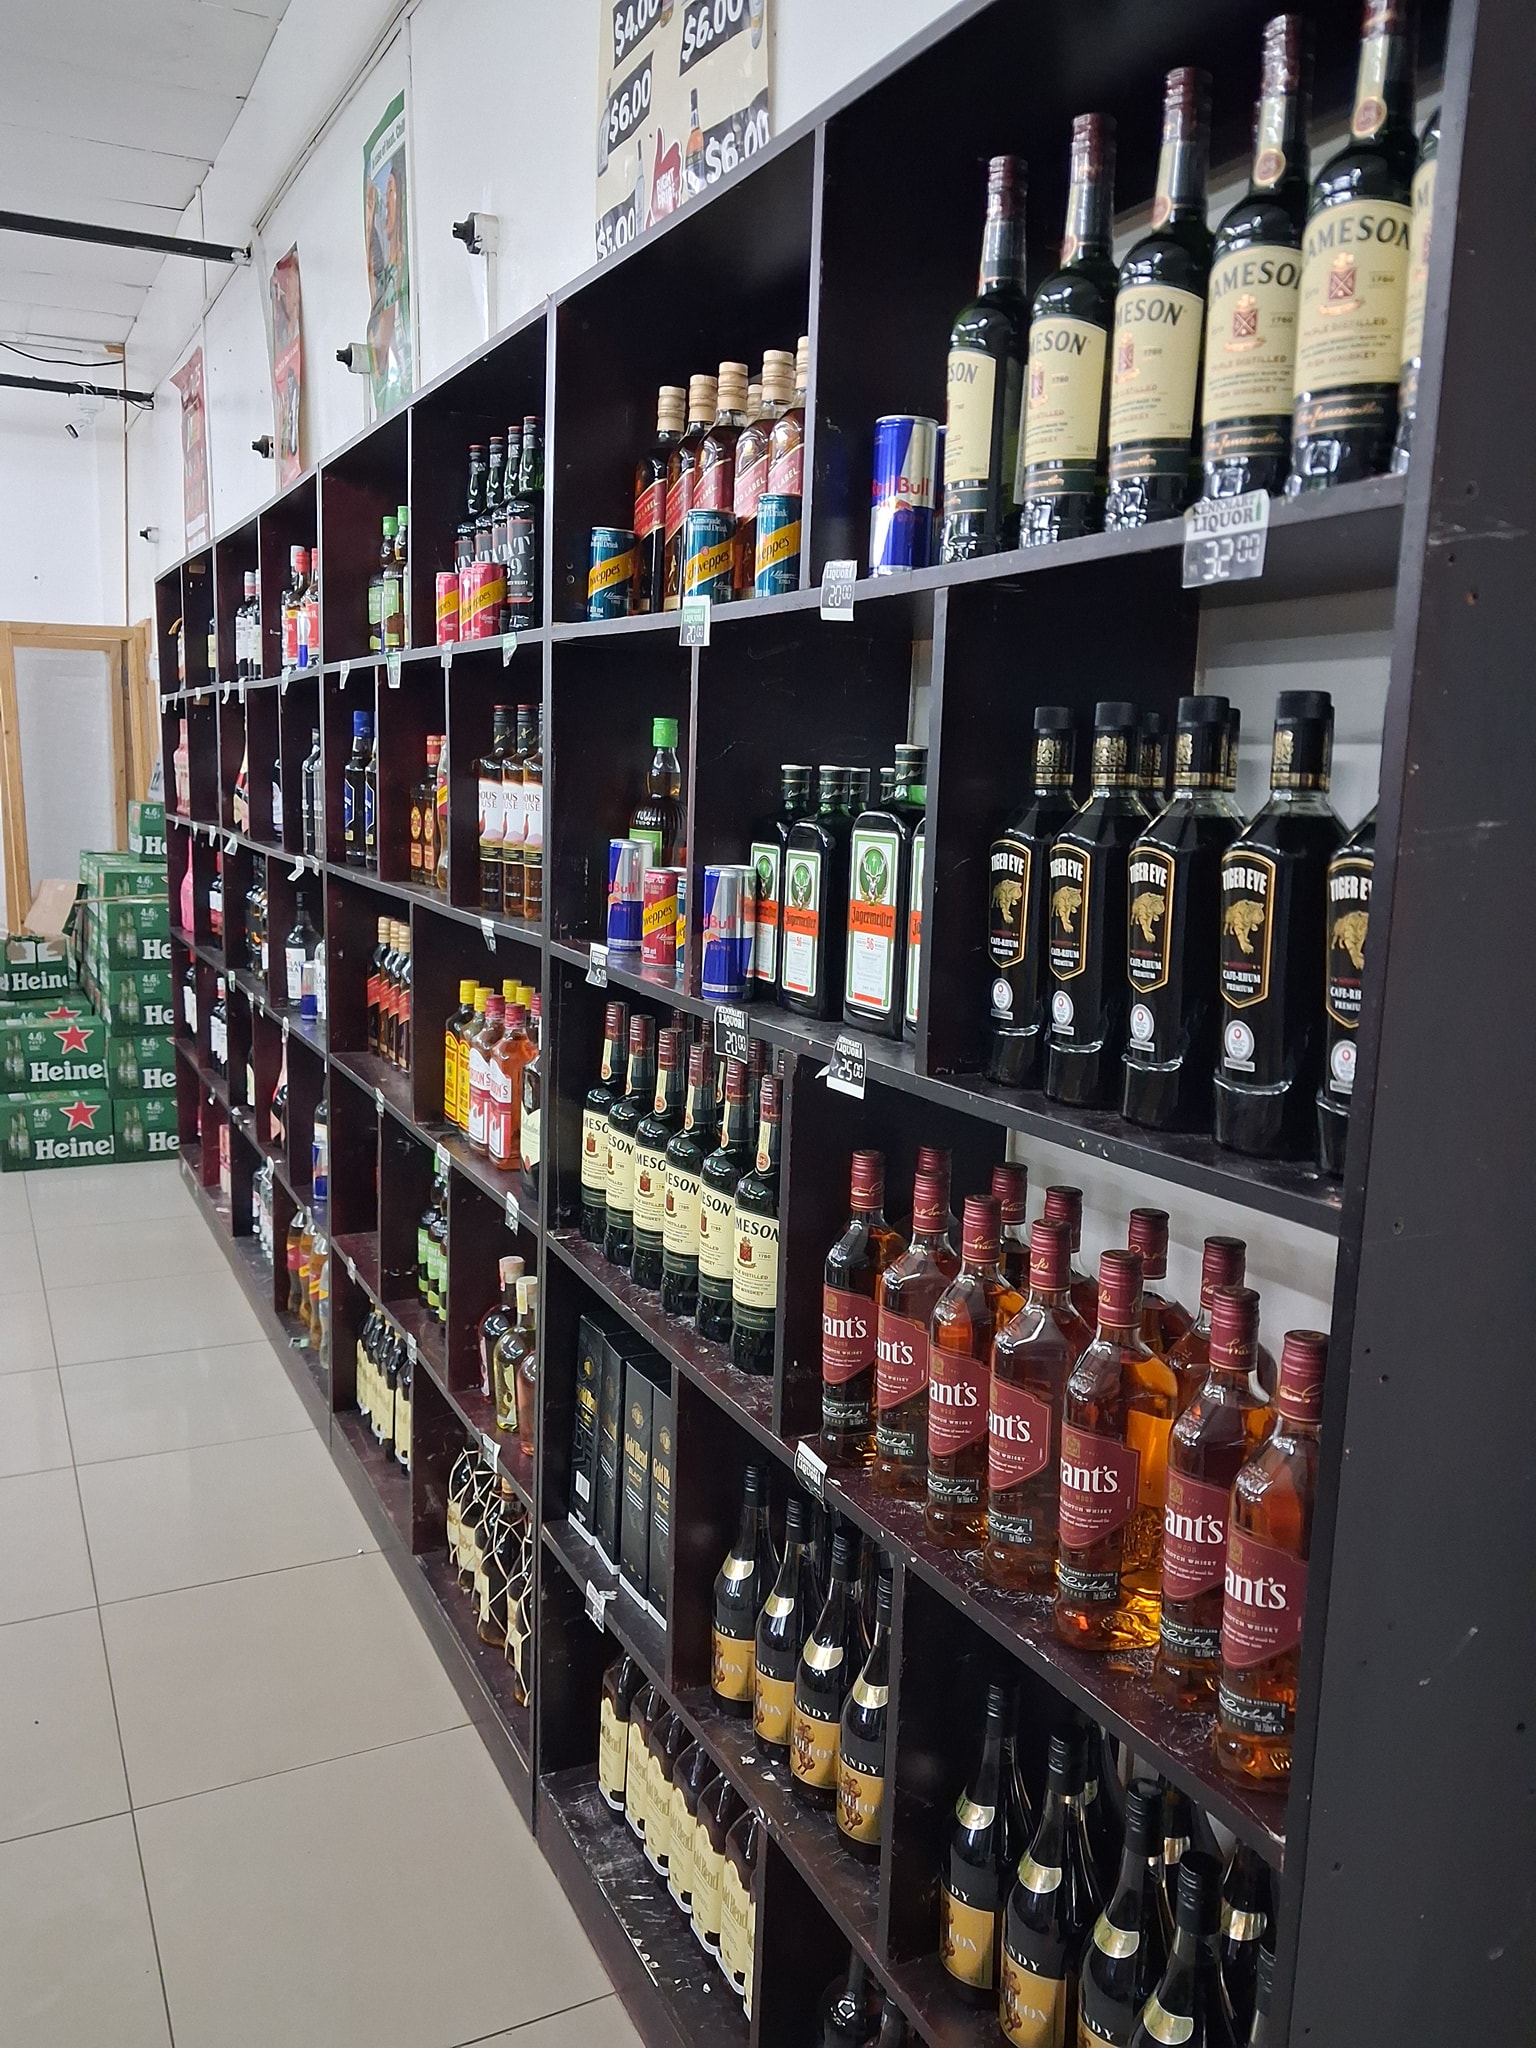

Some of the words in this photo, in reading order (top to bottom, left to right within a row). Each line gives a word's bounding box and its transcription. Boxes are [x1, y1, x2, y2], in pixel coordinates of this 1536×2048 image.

[610, 69, 651, 143] $6.00
[706, 109, 768, 183] $6.00
[897, 475, 929, 497] Bull
[1193, 507, 1254, 533] LIQUOR
[1202, 538, 1235, 580] 32
[1237, 533, 1261, 563] 00
[828, 585, 841, 607] 20
[991, 853, 1008, 872] TIGER
[1008, 854, 1024, 875] EYE
[1050, 858, 1067, 878] TIGER
[1067, 859, 1084, 881] EYE
[1130, 862, 1150, 883] TIGER
[1150, 863, 1167, 887] EYE
[614, 881, 636, 895] Bull
[1222, 867, 1245, 891] TIGER
[1246, 869, 1267, 895] EYE
[1330, 875, 1358, 902] TIGER
[709, 915, 735, 930] Bull
[725, 1031, 738, 1055] 20
[838, 1058, 853, 1081] 25
[797, 1700, 832, 1721] ANDY
[843, 1753, 879, 1775] ANDY
[951, 1884, 969, 1902] DY
